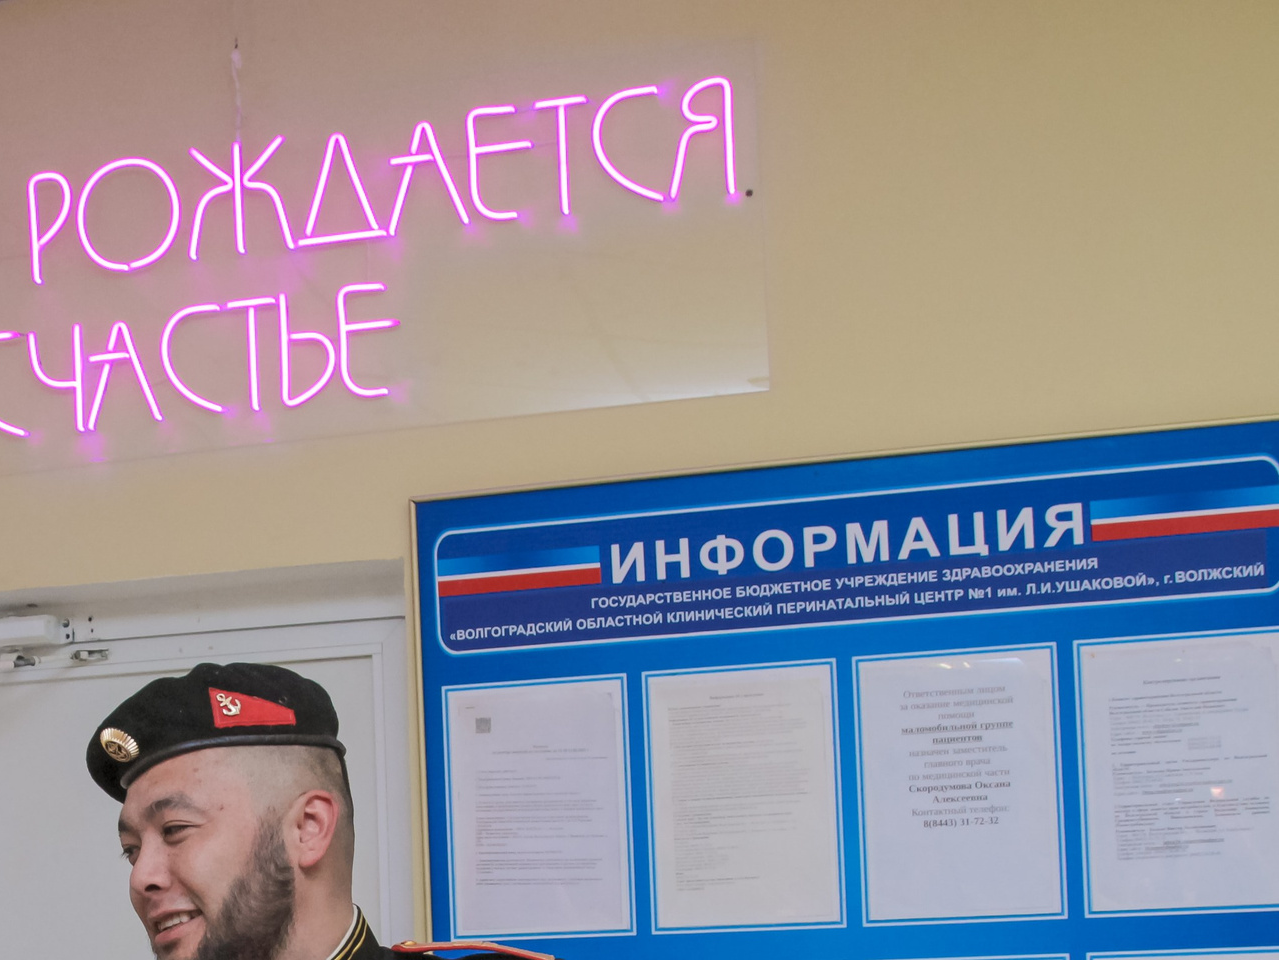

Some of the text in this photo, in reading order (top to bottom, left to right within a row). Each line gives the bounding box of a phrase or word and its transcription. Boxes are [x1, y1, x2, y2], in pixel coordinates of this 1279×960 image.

[27, 77, 737, 285] РОЖДАЕТСЯ
[610, 502, 1085, 585] ИНФОРМАЦИЯ
[449, 617, 573, 641] «ВОЛГОГРАДСКИЙ
[576, 610, 663, 631] ОБЛАСТНОЙ
[666, 602, 773, 624] КЛИНИЧЕСКИЙ
[777, 586, 910, 615] ПЕРИНАТАЛЬНЫЙ
[914, 588, 964, 606] ЦЕНТР
[968, 586, 992, 600] №1
[997, 586, 1022, 598] им.
[1025, 572, 1159, 596] Л.И.УШАКОВОЙ»,
[591, 557, 1098, 609] ГОСУДАРСТВЕННОЕ БЮДЖЕТНОЕ УЧРЕЖДЕНИЕ ЗДРАВООХРАНЕНИЯ
